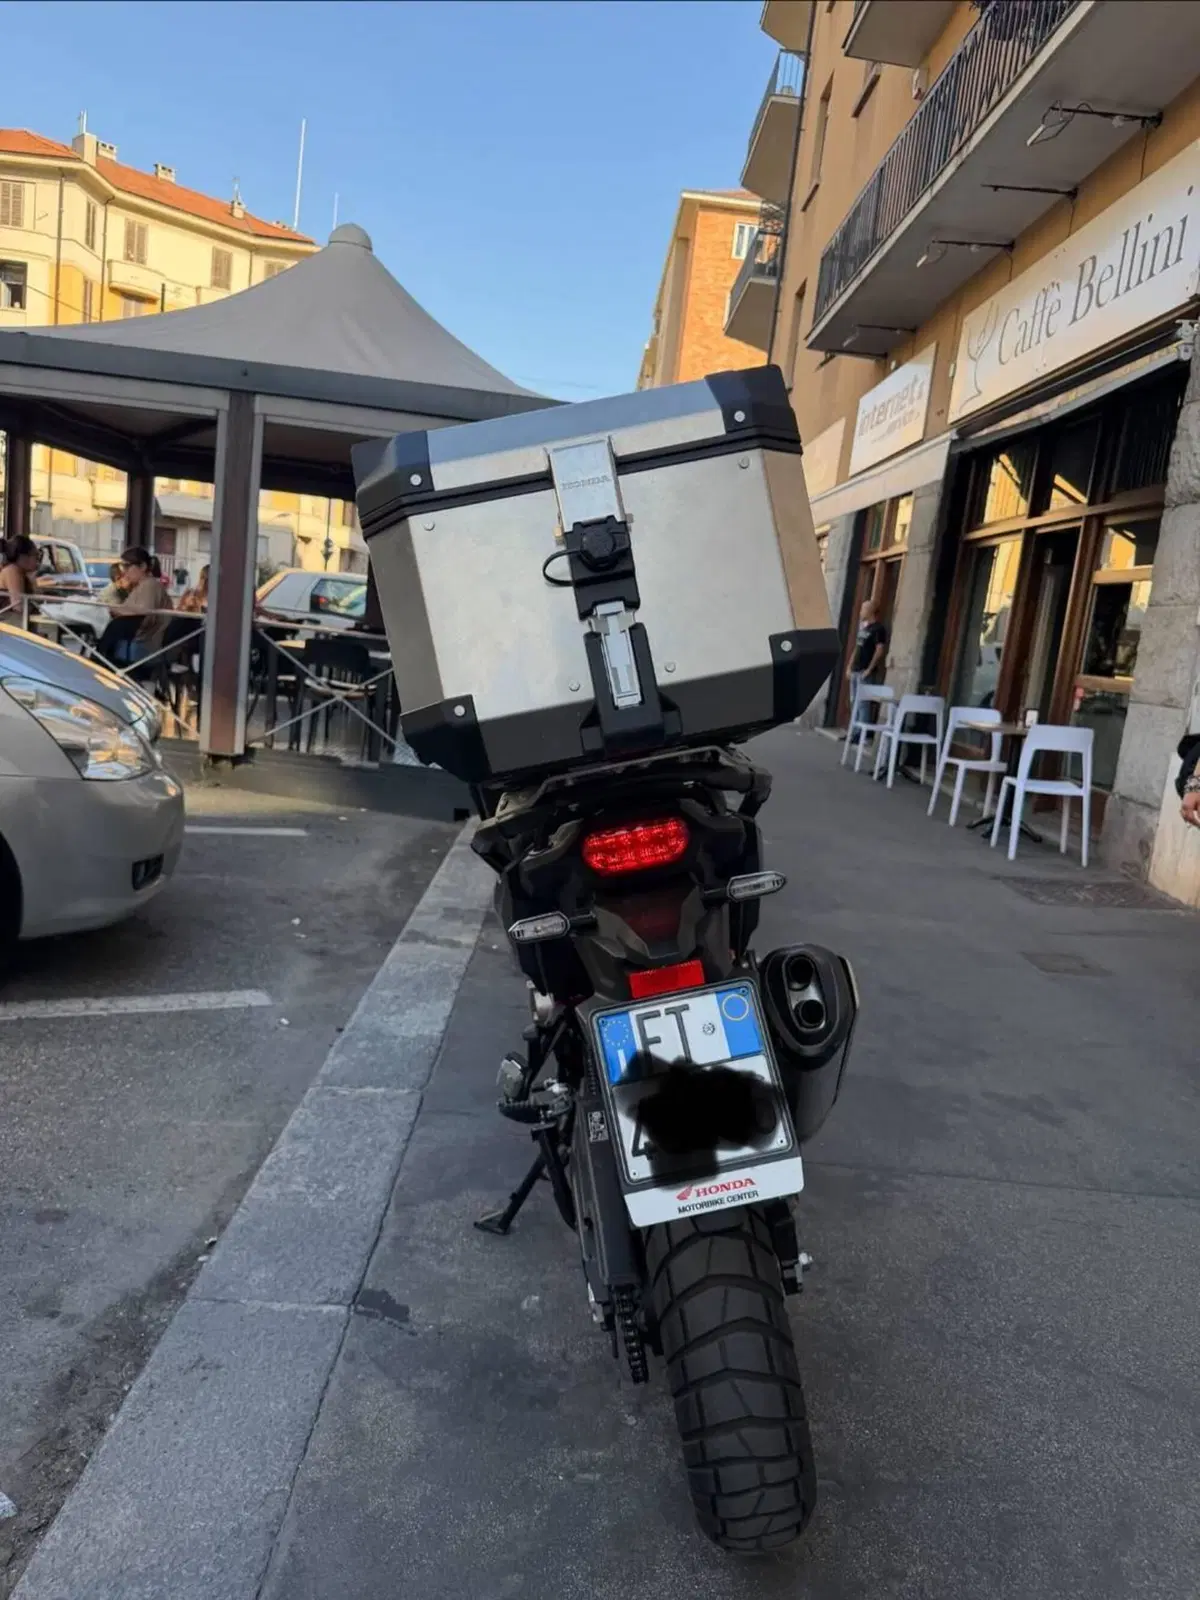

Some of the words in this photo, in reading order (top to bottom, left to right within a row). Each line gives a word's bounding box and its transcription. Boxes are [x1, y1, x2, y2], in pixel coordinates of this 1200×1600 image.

[998, 281, 1062, 365] Caffè
[1069, 185, 1194, 326] Bellini
[695, 1178, 756, 1197] HONDA
[677, 1196, 725, 1214] MOTORBIKE
[726, 1190, 759, 1204] CENTER
